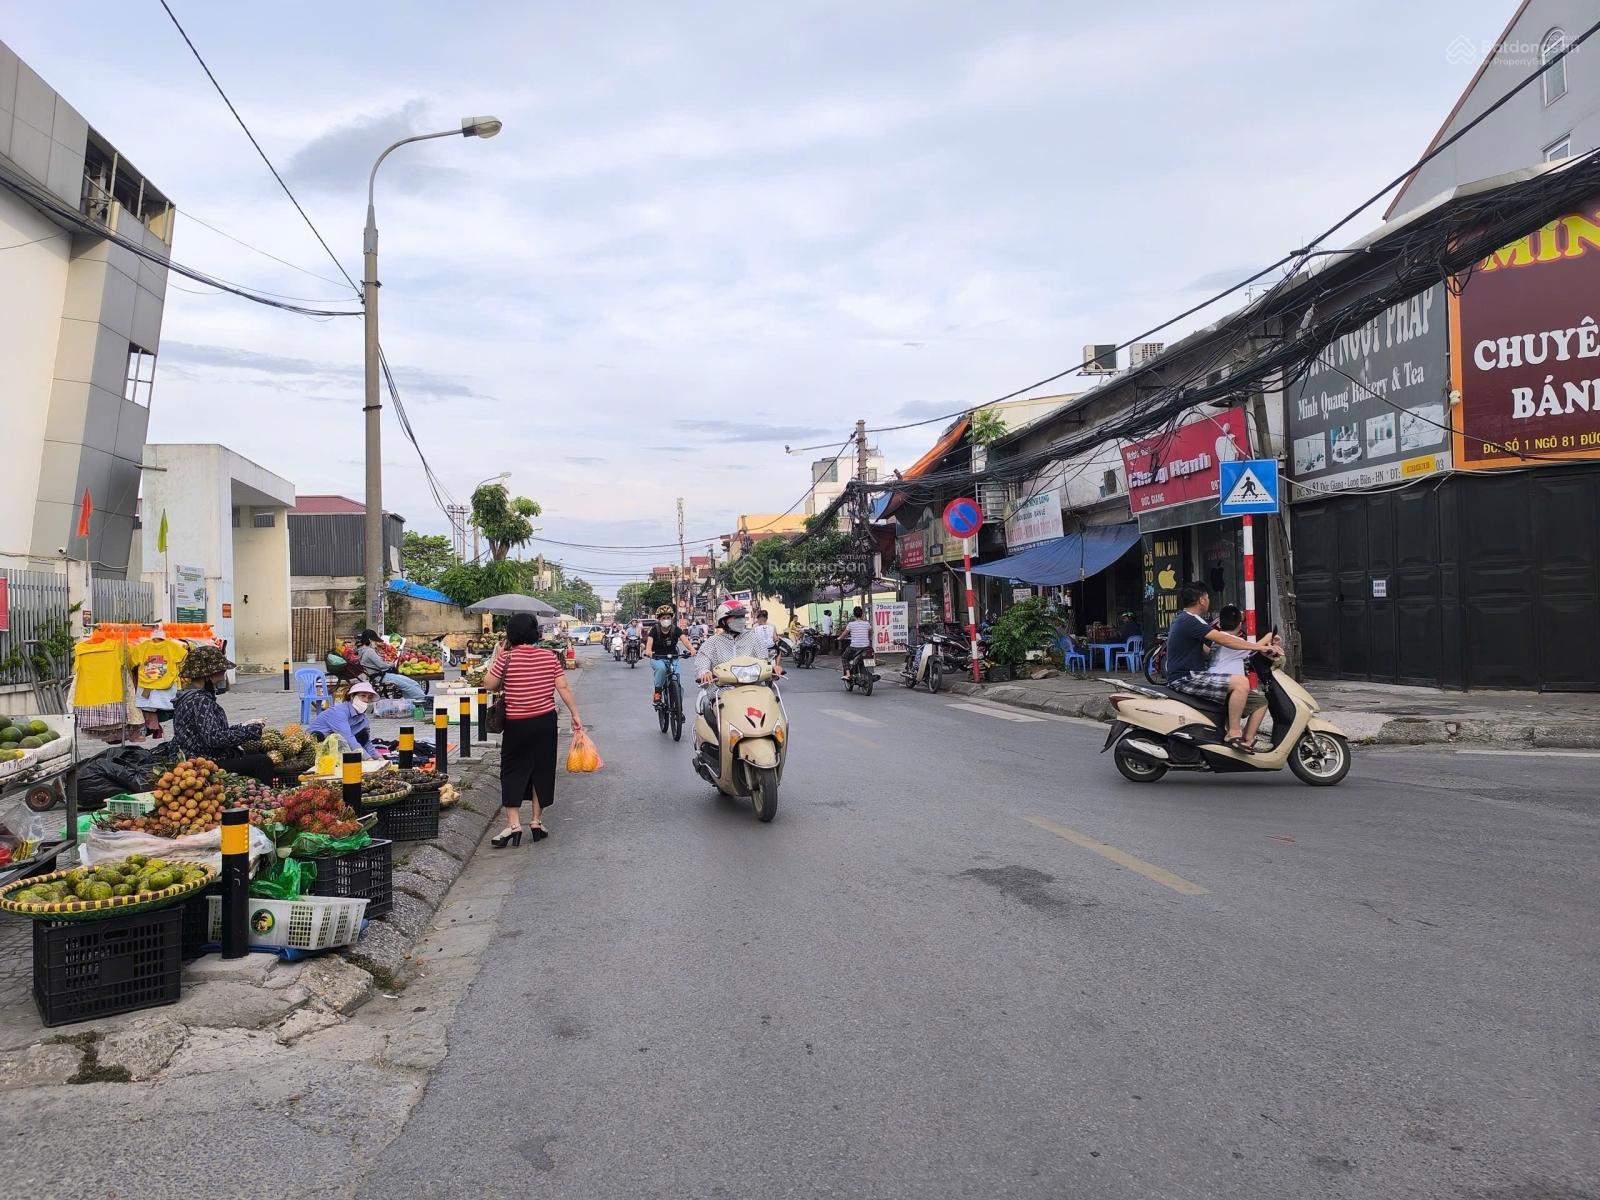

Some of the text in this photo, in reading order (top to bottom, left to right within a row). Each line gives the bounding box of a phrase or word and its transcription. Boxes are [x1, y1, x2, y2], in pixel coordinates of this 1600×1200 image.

[1474, 316, 1600, 371] CHUYÊ
[1298, 361, 1425, 421] Minh Quang Bakery & Tea
[1525, 440, 1530, 450] 1
[1562, 435, 1575, 447] 81
[1375, 470, 1384, 483] HN
[1436, 458, 1445, 471] 03
[875, 611, 891, 628] VỊT
